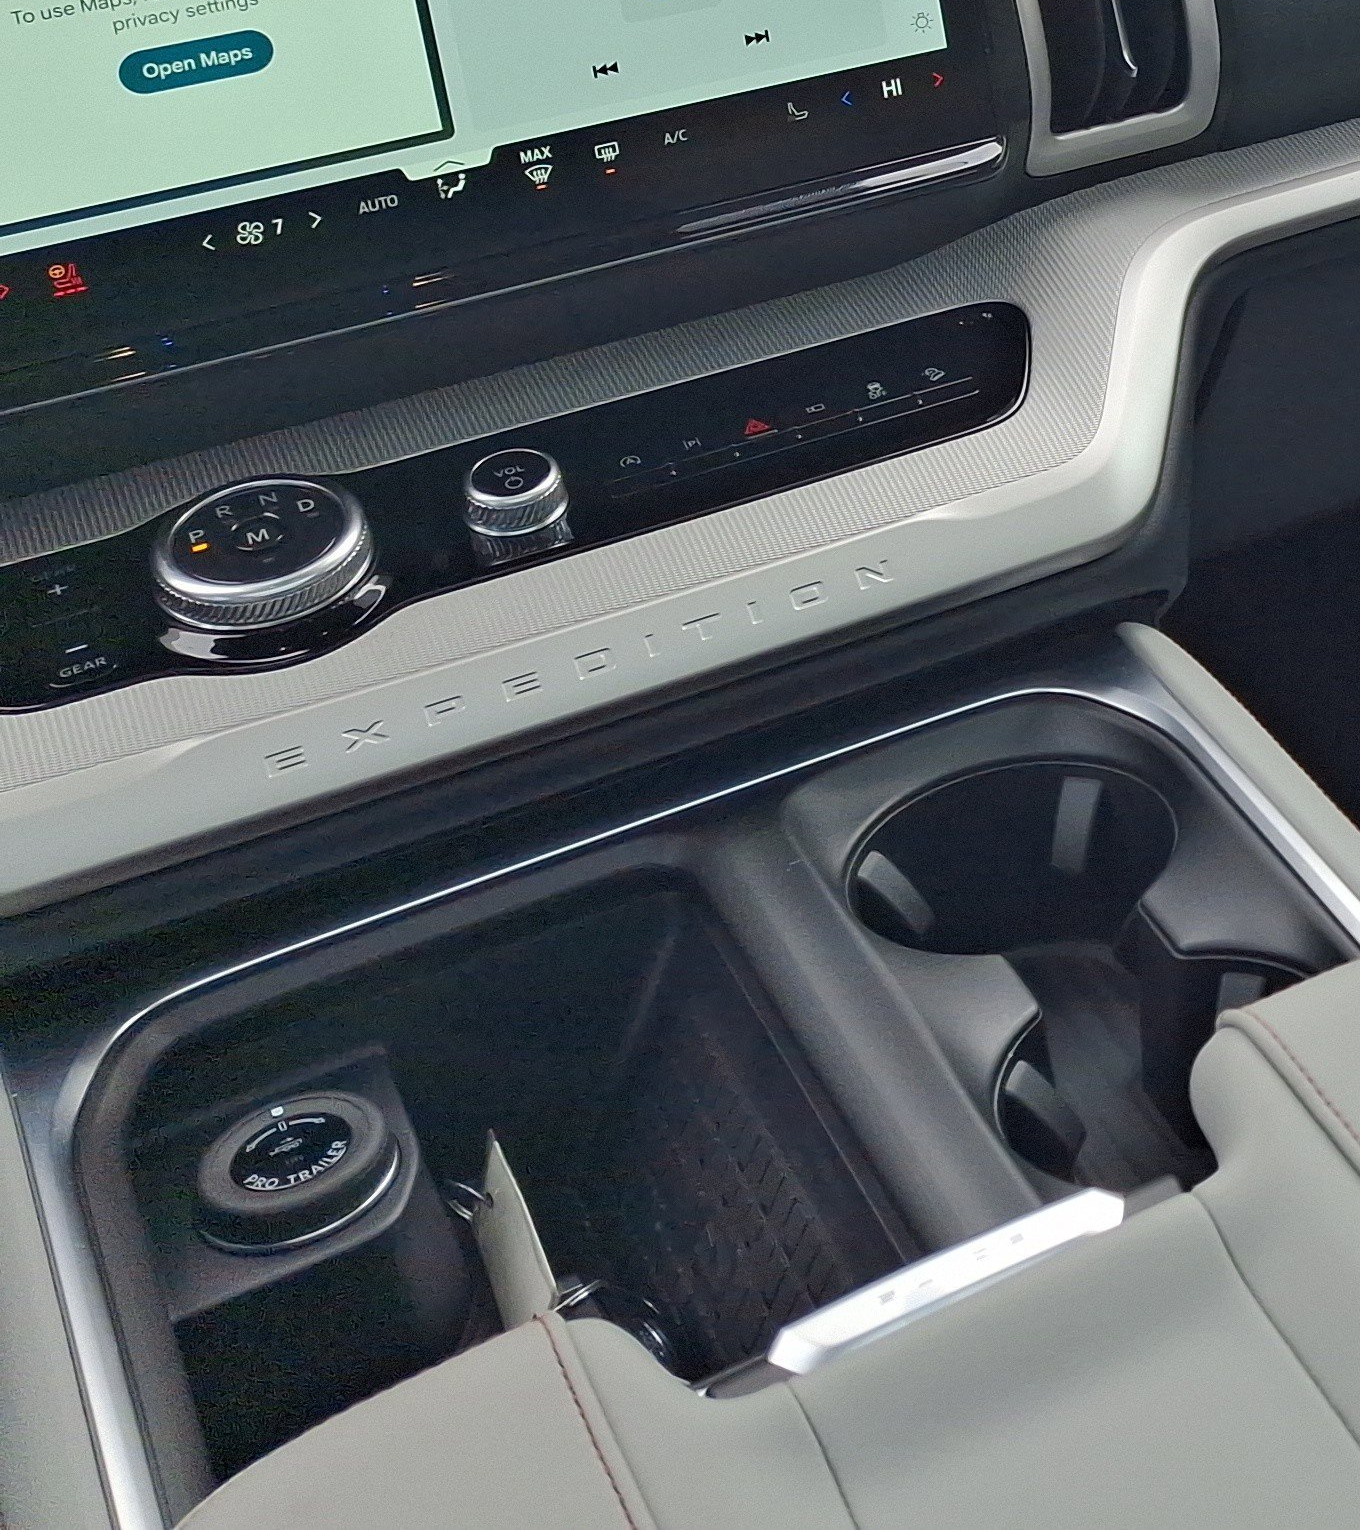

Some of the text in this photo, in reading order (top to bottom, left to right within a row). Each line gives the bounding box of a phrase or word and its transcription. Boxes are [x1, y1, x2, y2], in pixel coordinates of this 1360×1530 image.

[11, 9, 35, 26] To
[41, 4, 75, 21] use
[112, 6, 180, 36] privacy
[142, 45, 253, 80] Open Maps
[881, 77, 903, 99] HI
[663, 127, 689, 146] A/C
[519, 144, 553, 163] MAX
[358, 193, 399, 216] AUTO
[271, 218, 284, 237] 7
[493, 463, 526, 478] VOL
[188, 491, 316, 544] P R N D
[246, 527, 271, 546] M
[59, 655, 107, 678] GEAR
[265, 557, 894, 779] EXPEDITION
[243, 1139, 348, 1190] PRO TRAILER
